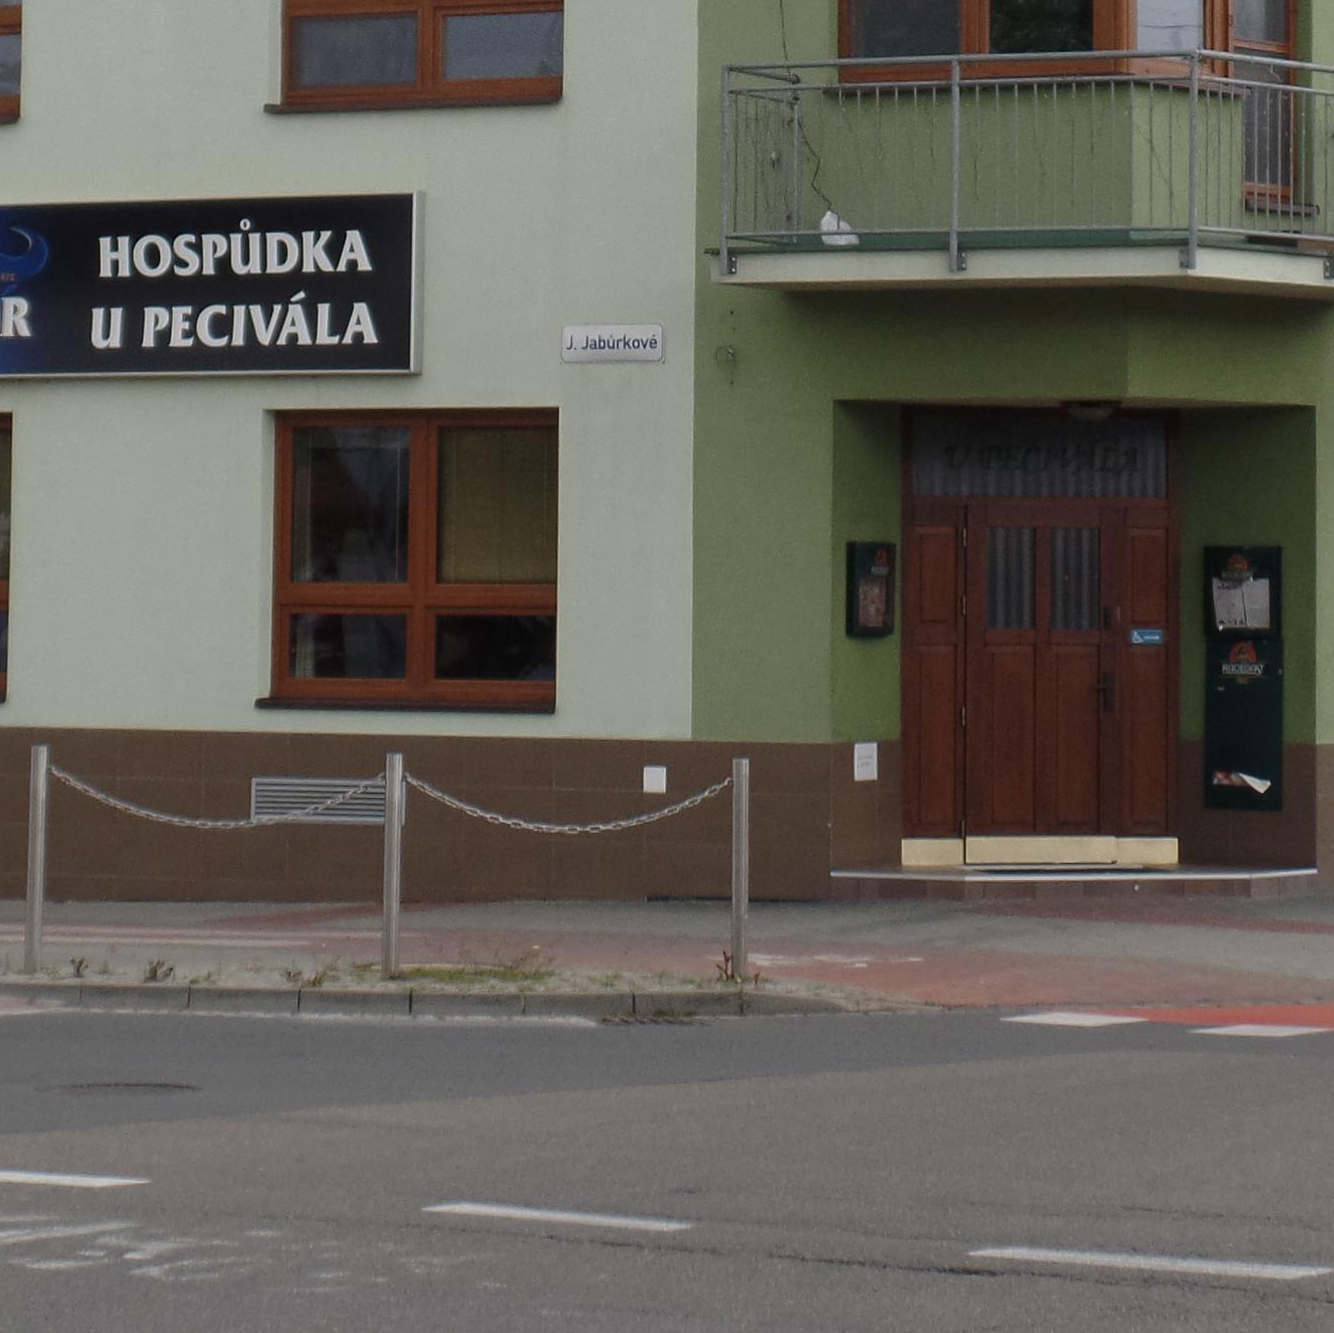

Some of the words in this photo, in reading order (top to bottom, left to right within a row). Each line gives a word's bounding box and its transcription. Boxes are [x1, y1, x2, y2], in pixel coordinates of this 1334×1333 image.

[98, 218, 373, 278] HOSPŮDKA
[91, 306, 123, 349] U
[141, 290, 379, 348] PECIVÁLA
[565, 334, 578, 351] J.
[581, 333, 658, 350] Jabůrkové
